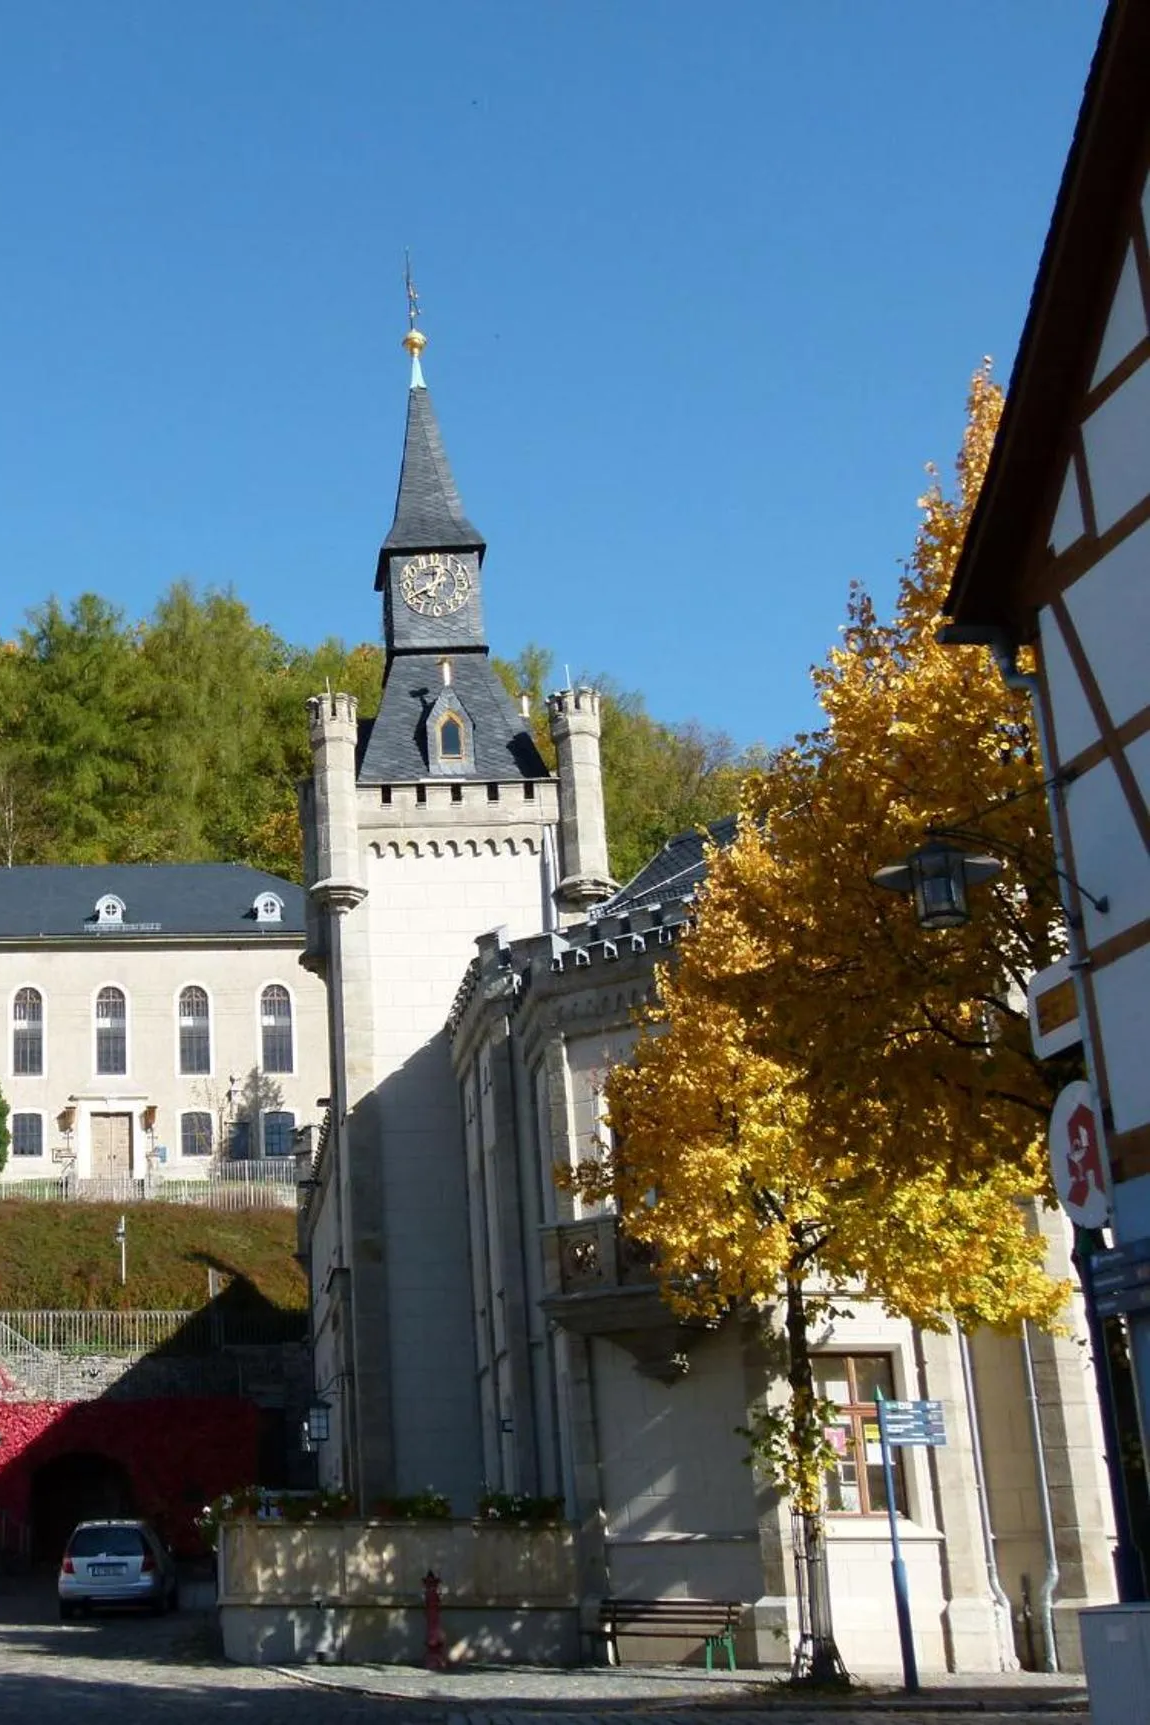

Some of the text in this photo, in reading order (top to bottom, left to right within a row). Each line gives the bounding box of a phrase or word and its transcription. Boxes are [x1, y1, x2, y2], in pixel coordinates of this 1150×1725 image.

[429, 553, 440, 565] 12
[403, 564, 417, 578] 10
[456, 563, 464, 577] 2
[403, 579, 412, 591] 9
[457, 577, 468, 590] 3
[433, 602, 443, 617] 6
